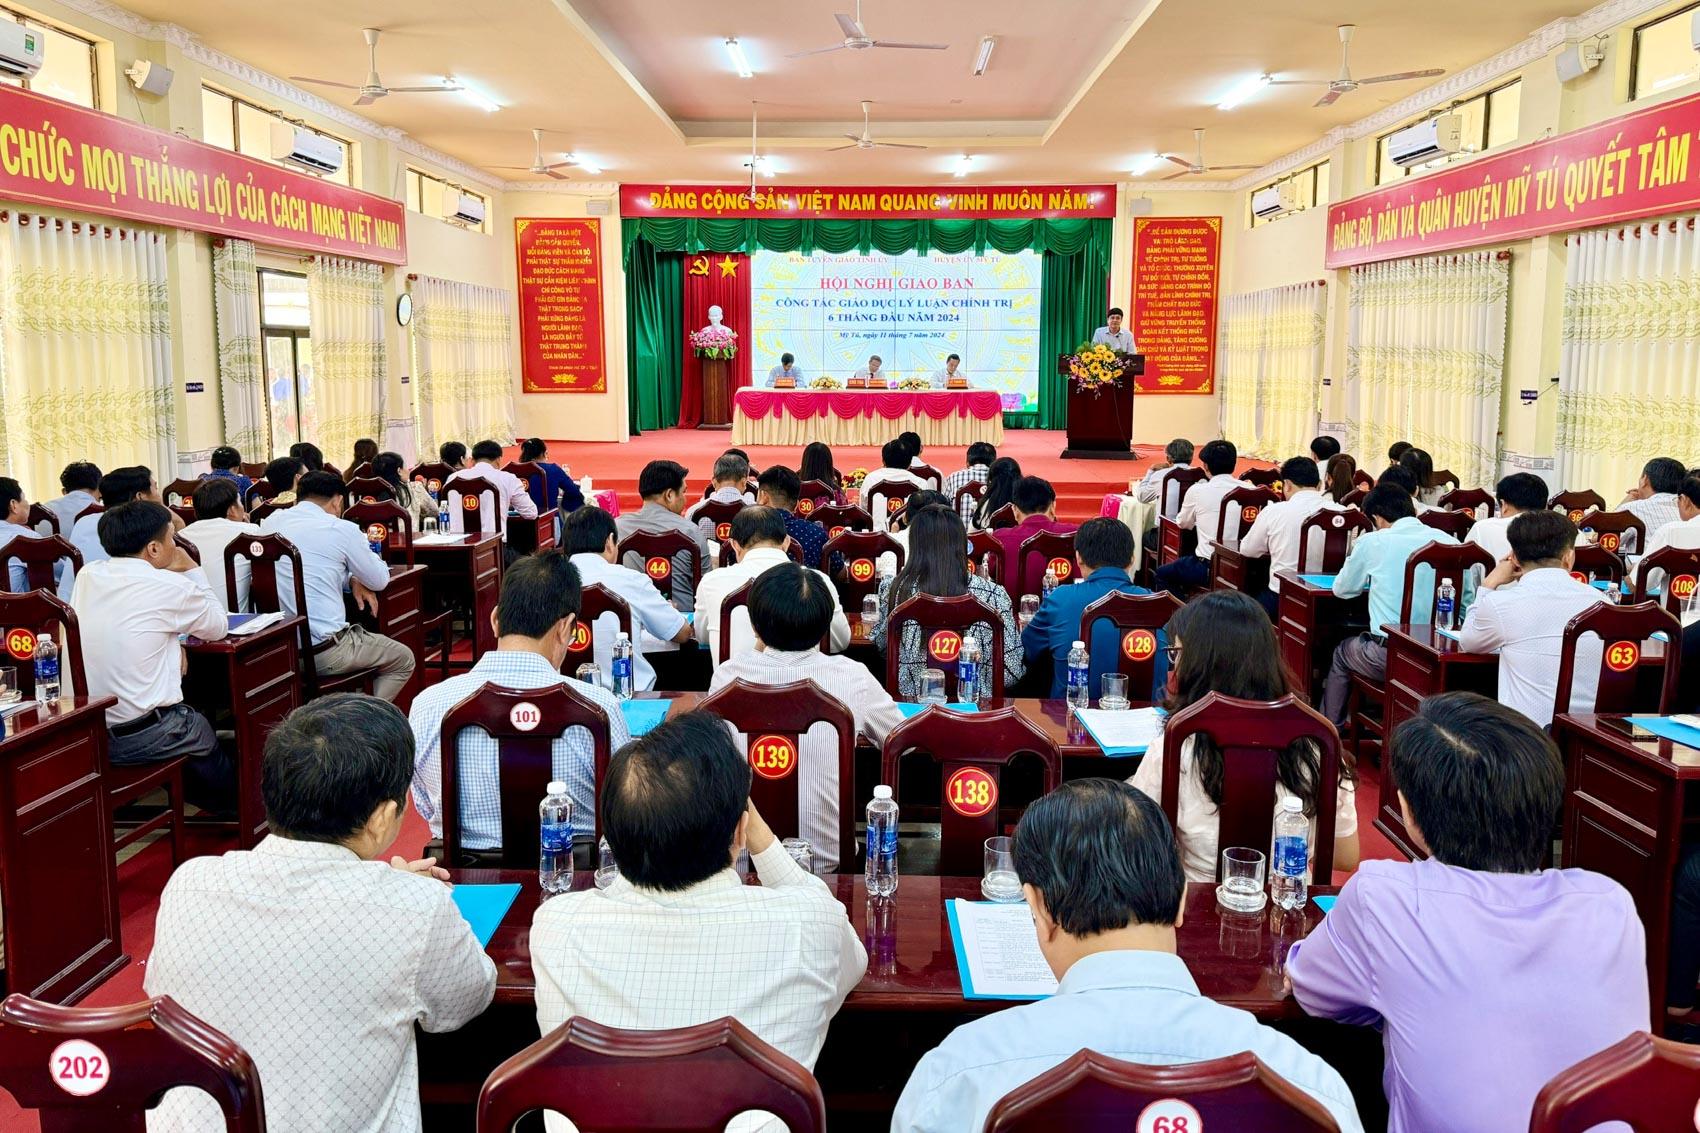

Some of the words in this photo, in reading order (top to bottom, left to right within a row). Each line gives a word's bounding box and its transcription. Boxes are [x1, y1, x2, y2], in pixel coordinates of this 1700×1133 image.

[0, 121, 75, 187] CHỨC
[81, 144, 127, 204] MỌI
[131, 146, 200, 211] THẮNG
[203, 172, 233, 224] LỢI
[236, 172, 268, 224] CỦA
[271, 185, 308, 233] CÁCH
[311, 202, 346, 244] MẠNG
[348, 208, 372, 250] VIỆT
[375, 223, 400, 251] NAM!
[1334, 212, 1356, 252] ĐẢNG
[1358, 208, 1375, 252] BỘ,
[1377, 202, 1398, 241] DÂN
[1401, 194, 1415, 236] VÀ
[1418, 188, 1452, 242] QUÂN
[1454, 174, 1501, 230] HUYỆN
[1505, 164, 1532, 216] MỸ
[1536, 154, 1558, 210] TÚ
[1563, 130, 1632, 214] QUYẾT
[1638, 126, 1691, 190] TÂM
[650, 186, 697, 210] ĐẢNG
[702, 189, 750, 214] CỘNG
[754, 188, 790, 210] SẢN
[796, 189, 833, 214] VIỆT
[838, 193, 875, 210] NAM
[880, 194, 942, 211] QUANG
[946, 194, 988, 210] VINH
[992, 189, 1042, 210] MUÔN
[1048, 189, 1095, 210] NĂM!
[820, 276, 848, 292] HỘI
[853, 278, 893, 292] NGHỊ
[898, 278, 938, 290] GIAO
[943, 278, 975, 290] BAN
[776, 297, 809, 308] CÔNG
[812, 297, 836, 308] TÁC
[838, 297, 868, 308] GIÁO
[872, 299, 896, 309] DỤC
[899, 297, 915, 308] LÝ
[952, 297, 990, 308] CHÍNH
[993, 299, 1012, 309] TRỊ
[828, 314, 834, 322] 6
[838, 312, 878, 322] THÁNG
[908, 312, 934, 322] NĂM
[937, 314, 960, 322] 2024
[862, 332, 878, 340] ngày
[888, 332, 907, 340] tháng
[465, 498, 476, 507] 10
[801, 503, 812, 511] 30
[890, 501, 901, 509] 79
[1245, 510, 1256, 518] 15
[1571, 513, 1582, 522] 36
[719, 527, 730, 536] 17
[1602, 538, 1616, 547] 16
[650, 561, 666, 574] 44
[854, 563, 871, 576] 99
[1674, 580, 1694, 593] 108
[11, 635, 33, 653] 68
[934, 638, 957, 654] 127
[1128, 638, 1152, 654] 128
[1611, 648, 1633, 664] 63
[514, 710, 537, 724] 101
[756, 746, 789, 770] 139
[954, 780, 990, 805] 138
[59, 1056, 103, 1079] 202
